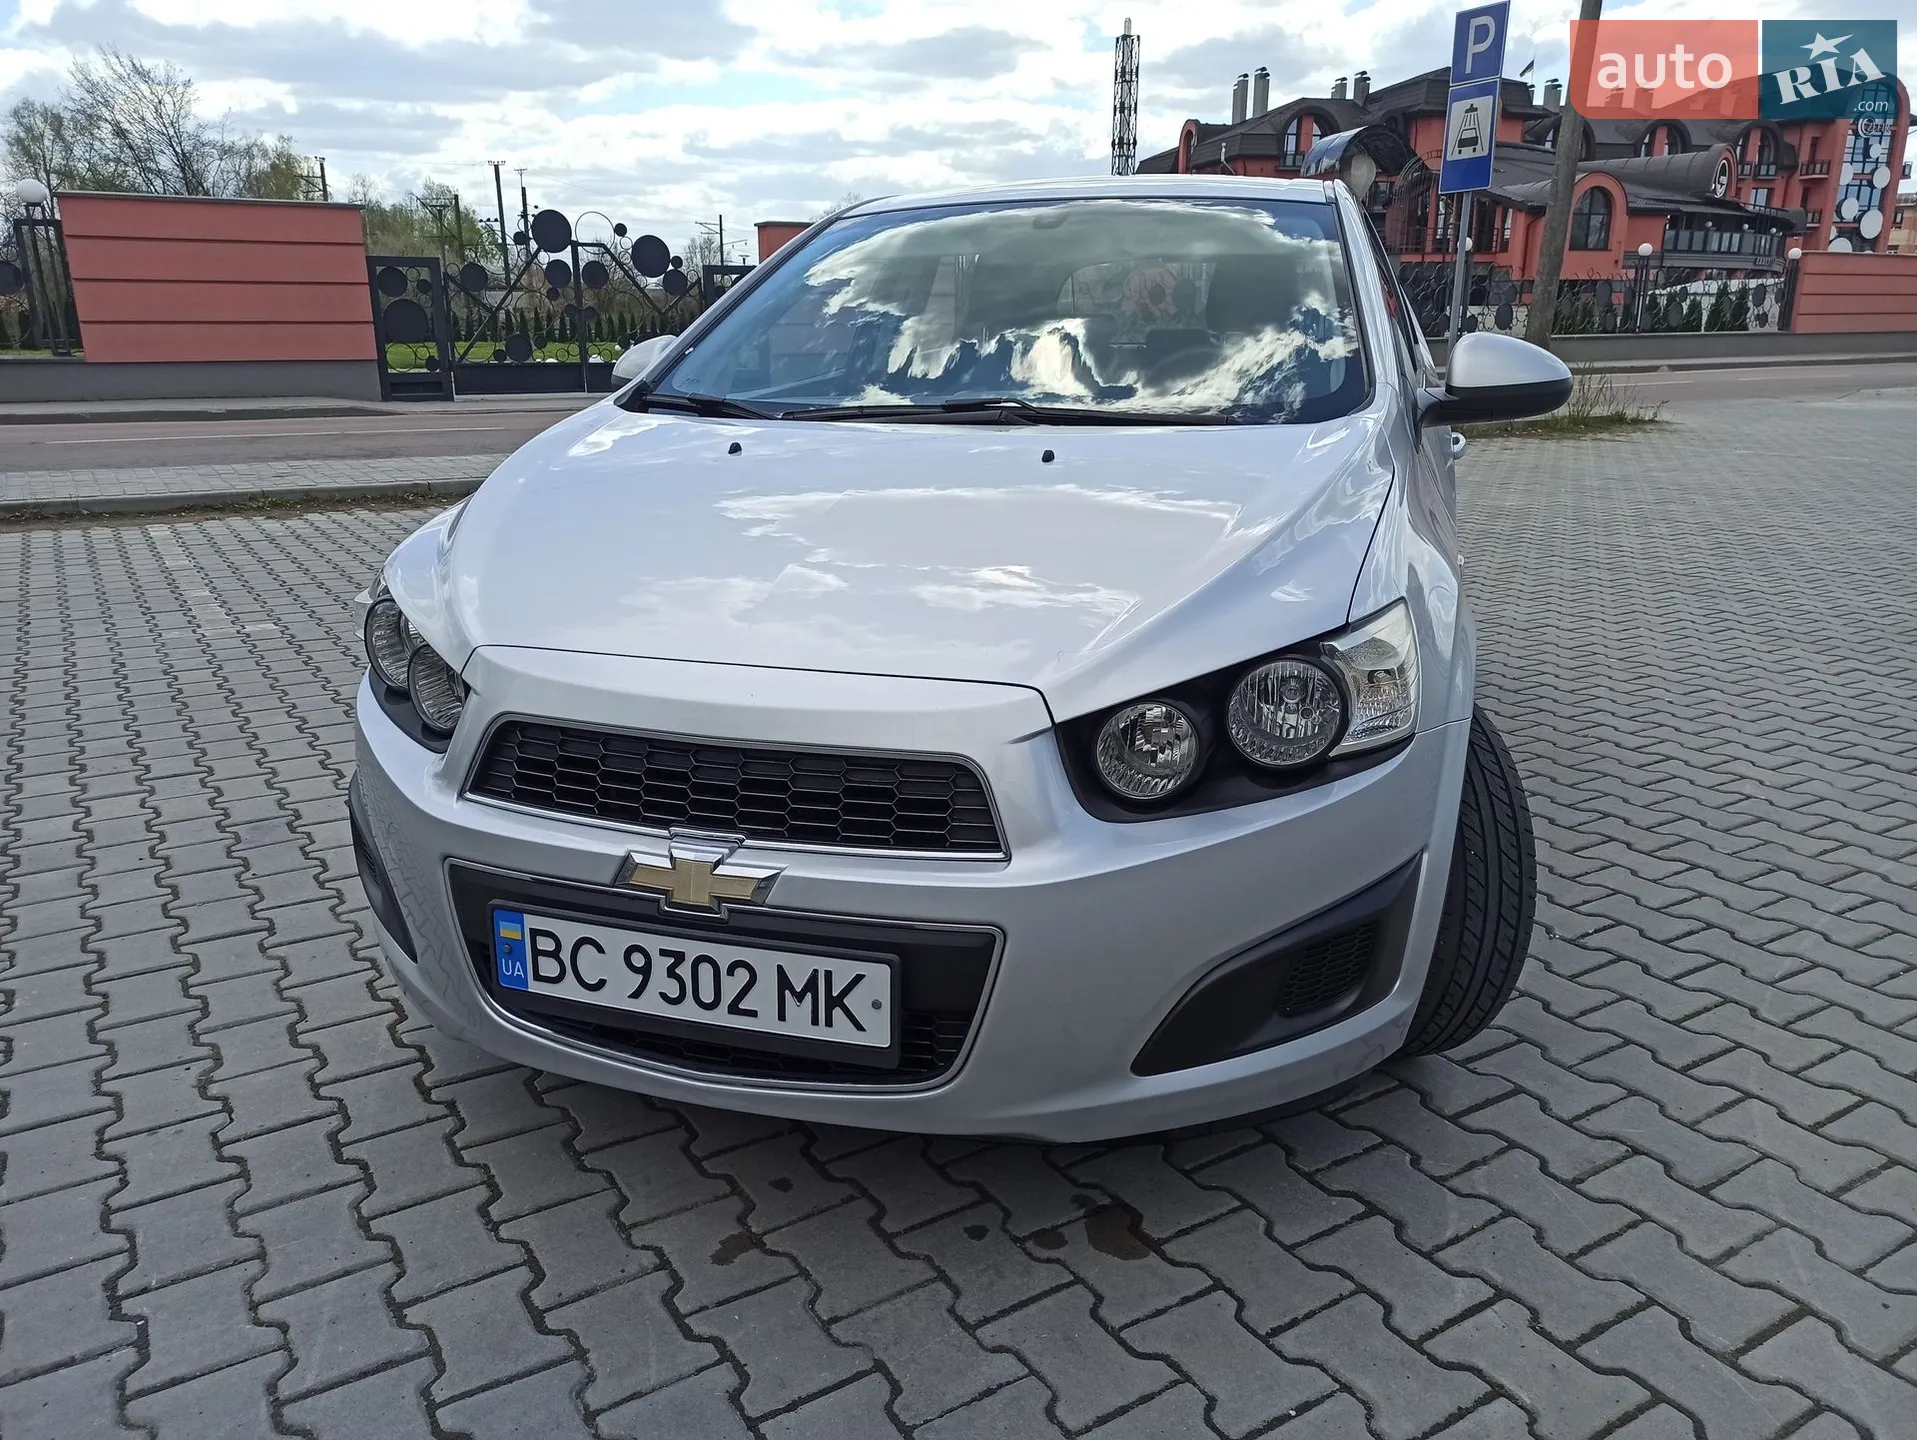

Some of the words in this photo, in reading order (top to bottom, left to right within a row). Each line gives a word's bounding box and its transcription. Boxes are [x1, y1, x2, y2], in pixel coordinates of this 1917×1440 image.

[1465, 15, 1496, 74] P
[501, 958, 525, 979] UA
[529, 927, 607, 992] BC
[623, 943, 759, 1019] 9302
[777, 963, 867, 1032] MK
